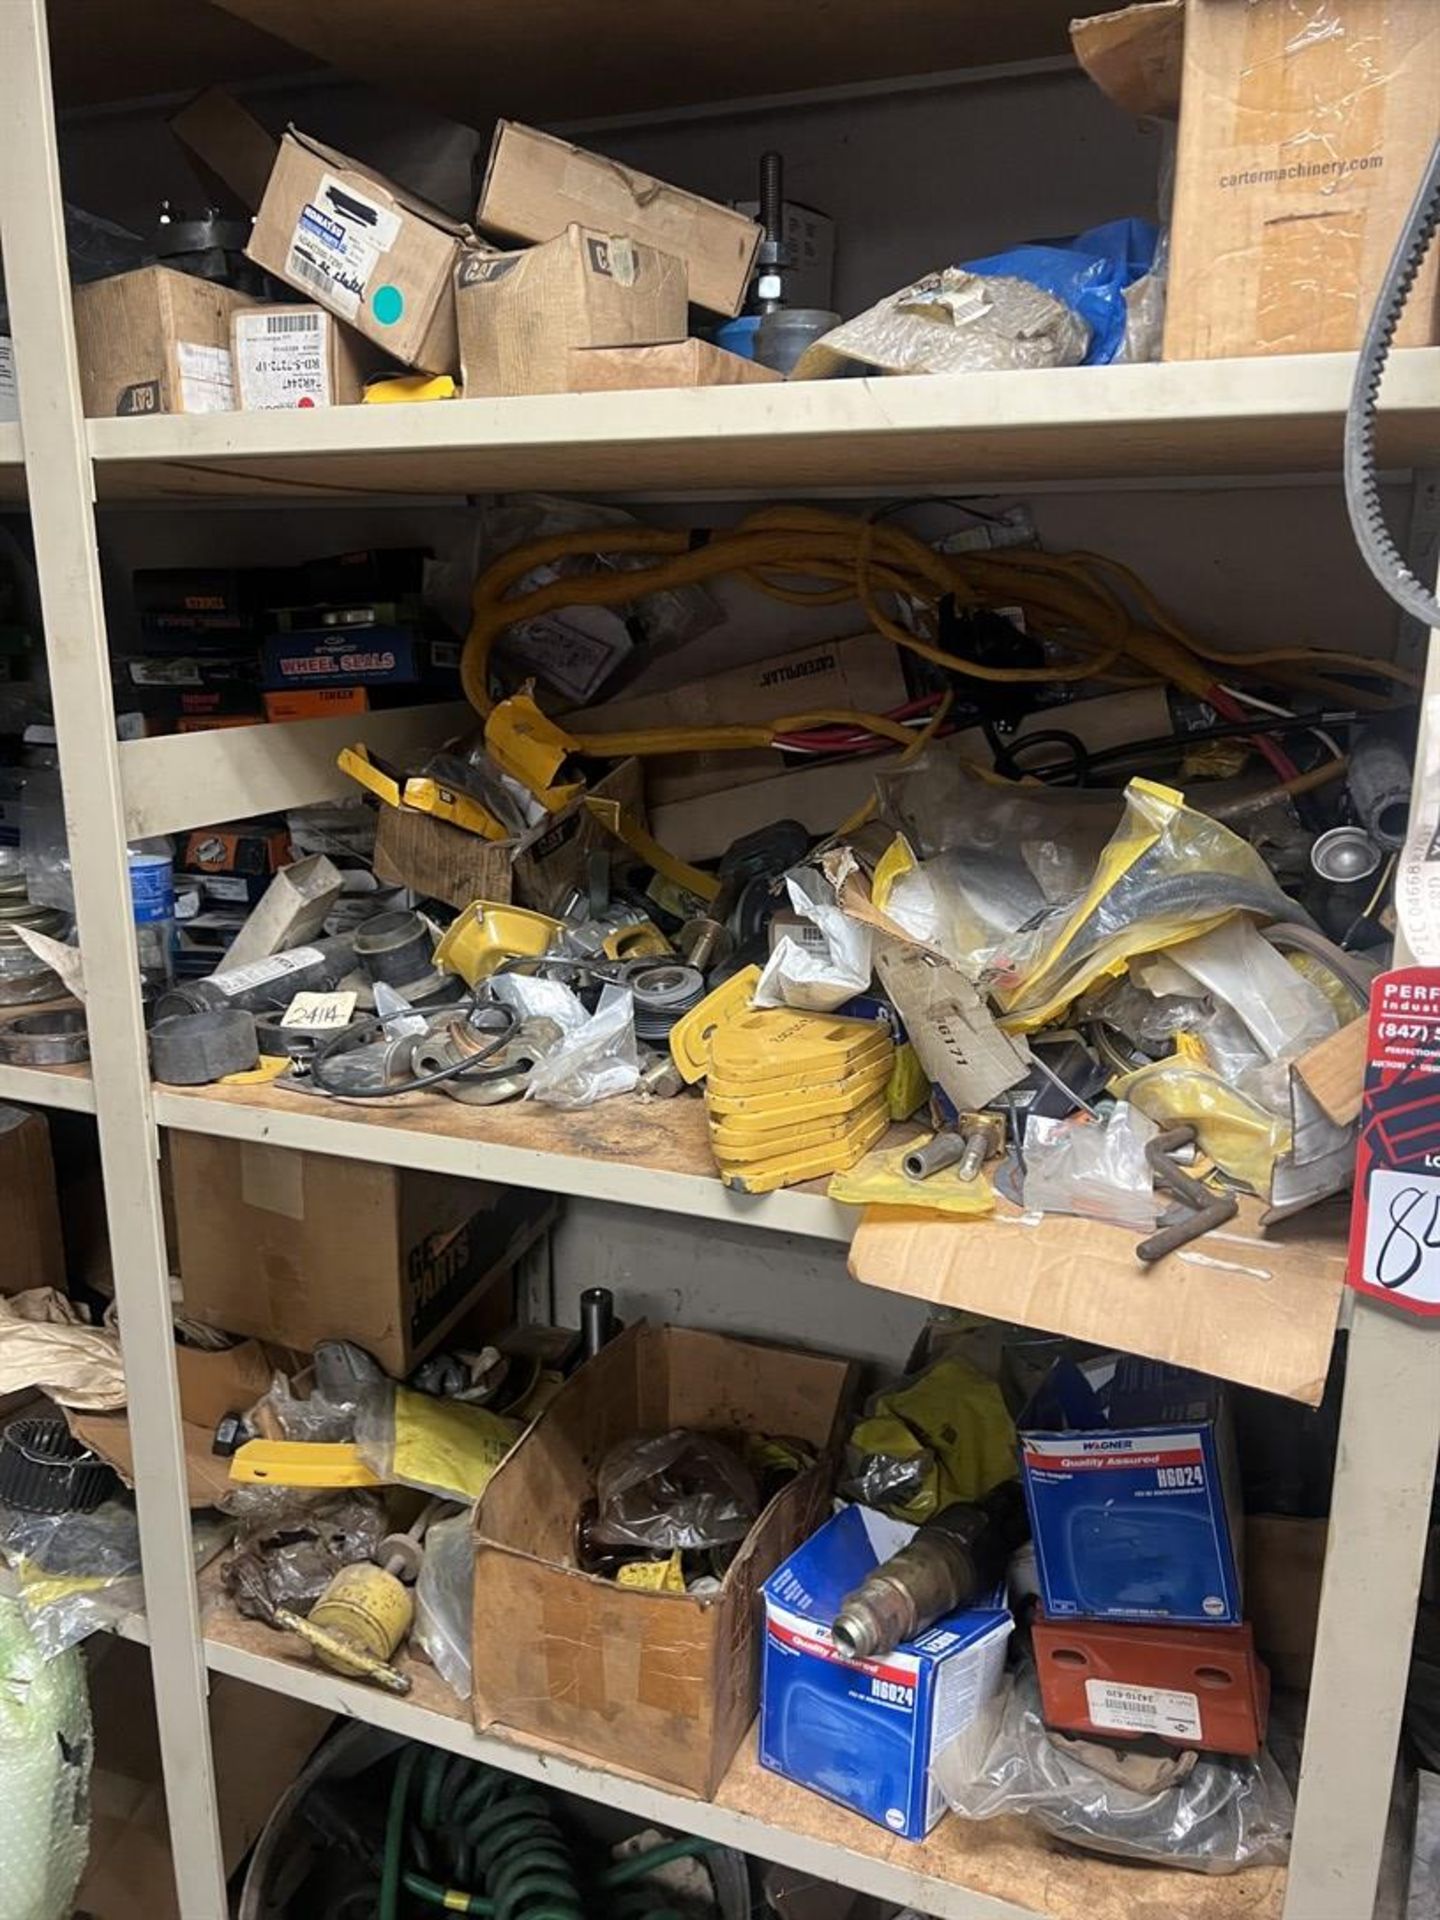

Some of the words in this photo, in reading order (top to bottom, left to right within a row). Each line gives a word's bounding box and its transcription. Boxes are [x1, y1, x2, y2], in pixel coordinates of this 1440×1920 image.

[1220, 156, 1383, 188] cartermachinery.com
[131, 387, 155, 411] CAT
[280, 656, 339, 676] WHEEL
[339, 651, 396, 673] SEALS
[1378, 1022, 1428, 1042] (847)
[1082, 1440, 1133, 1451] WAGNER
[1060, 1457, 1104, 1469] Quality
[1105, 1454, 1160, 1466] Assured
[1157, 1466, 1203, 1488] H6024
[791, 1635, 831, 1657] Quality
[871, 1678, 913, 1706] H6024
